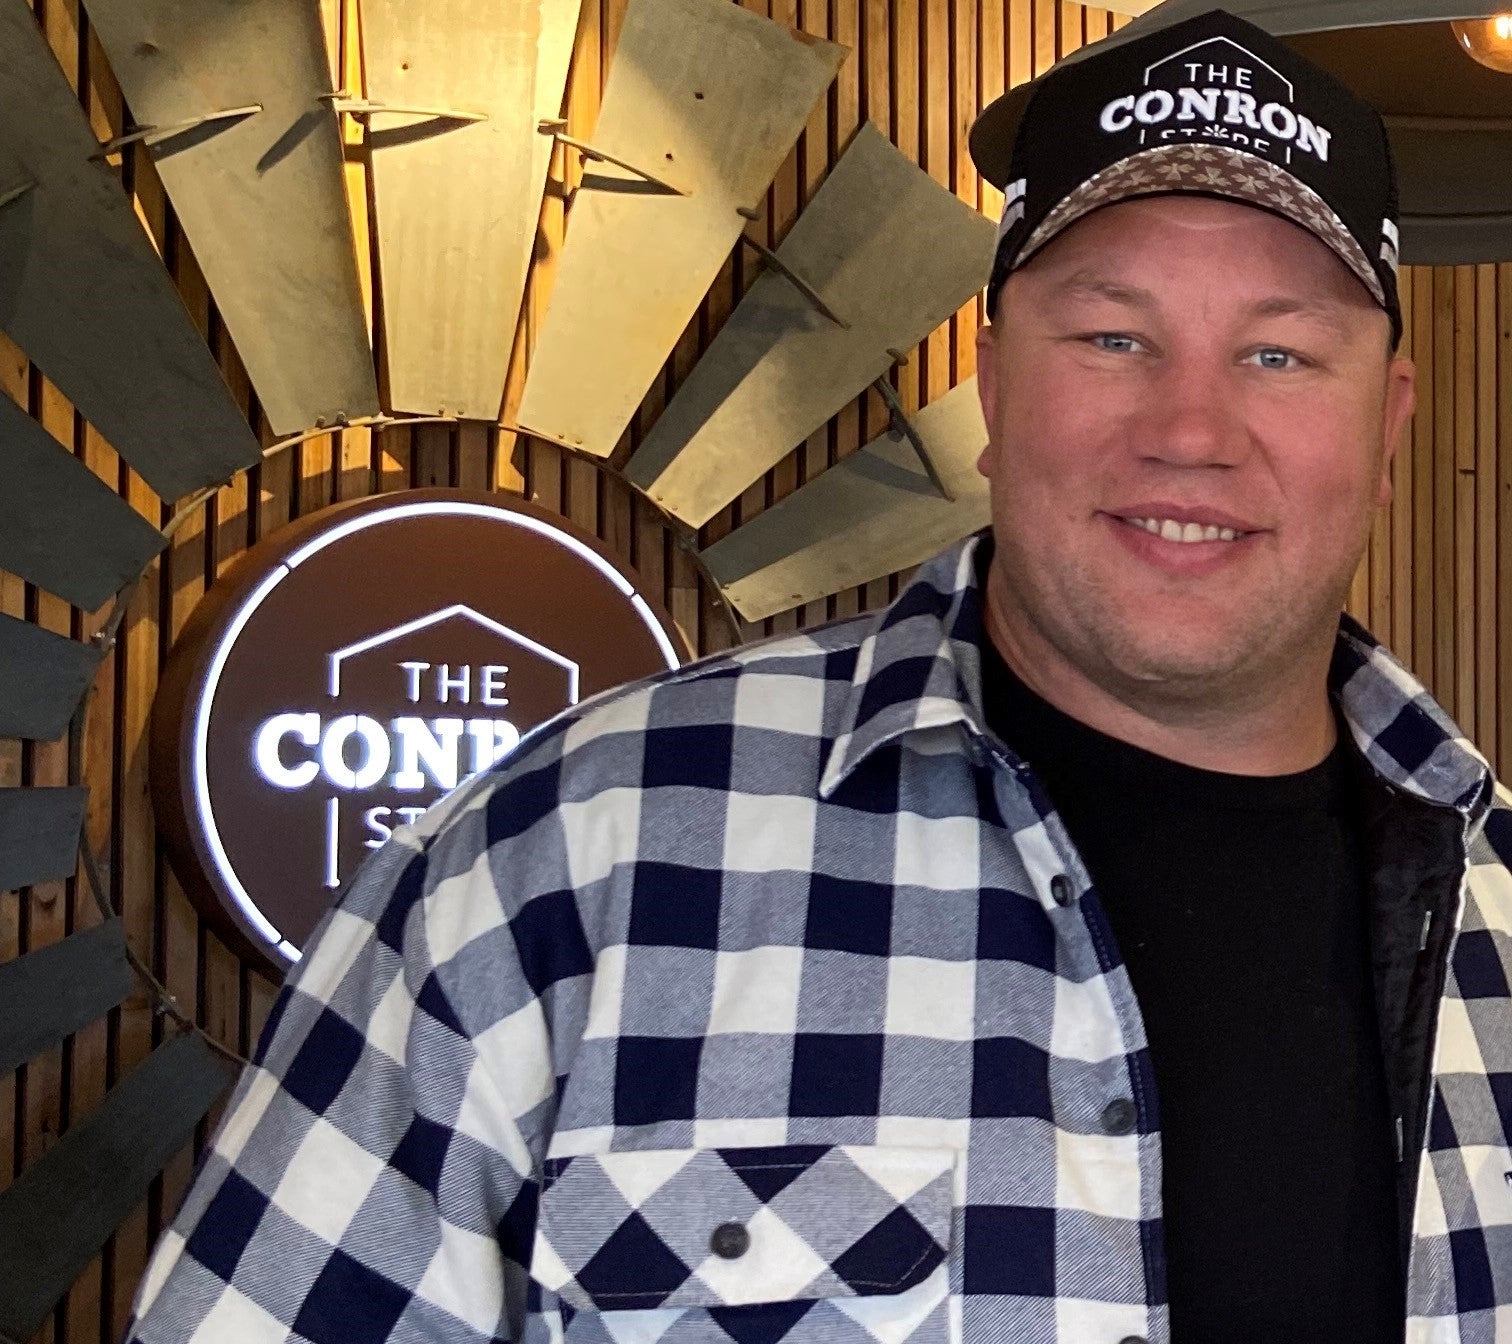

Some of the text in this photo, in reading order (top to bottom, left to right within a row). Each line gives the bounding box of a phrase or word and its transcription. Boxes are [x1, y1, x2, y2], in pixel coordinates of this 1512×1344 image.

[1184, 62, 1253, 89] THE
[1100, 87, 1331, 162] CONRON
[398, 660, 510, 706] THE
[255, 711, 521, 790] CONR
